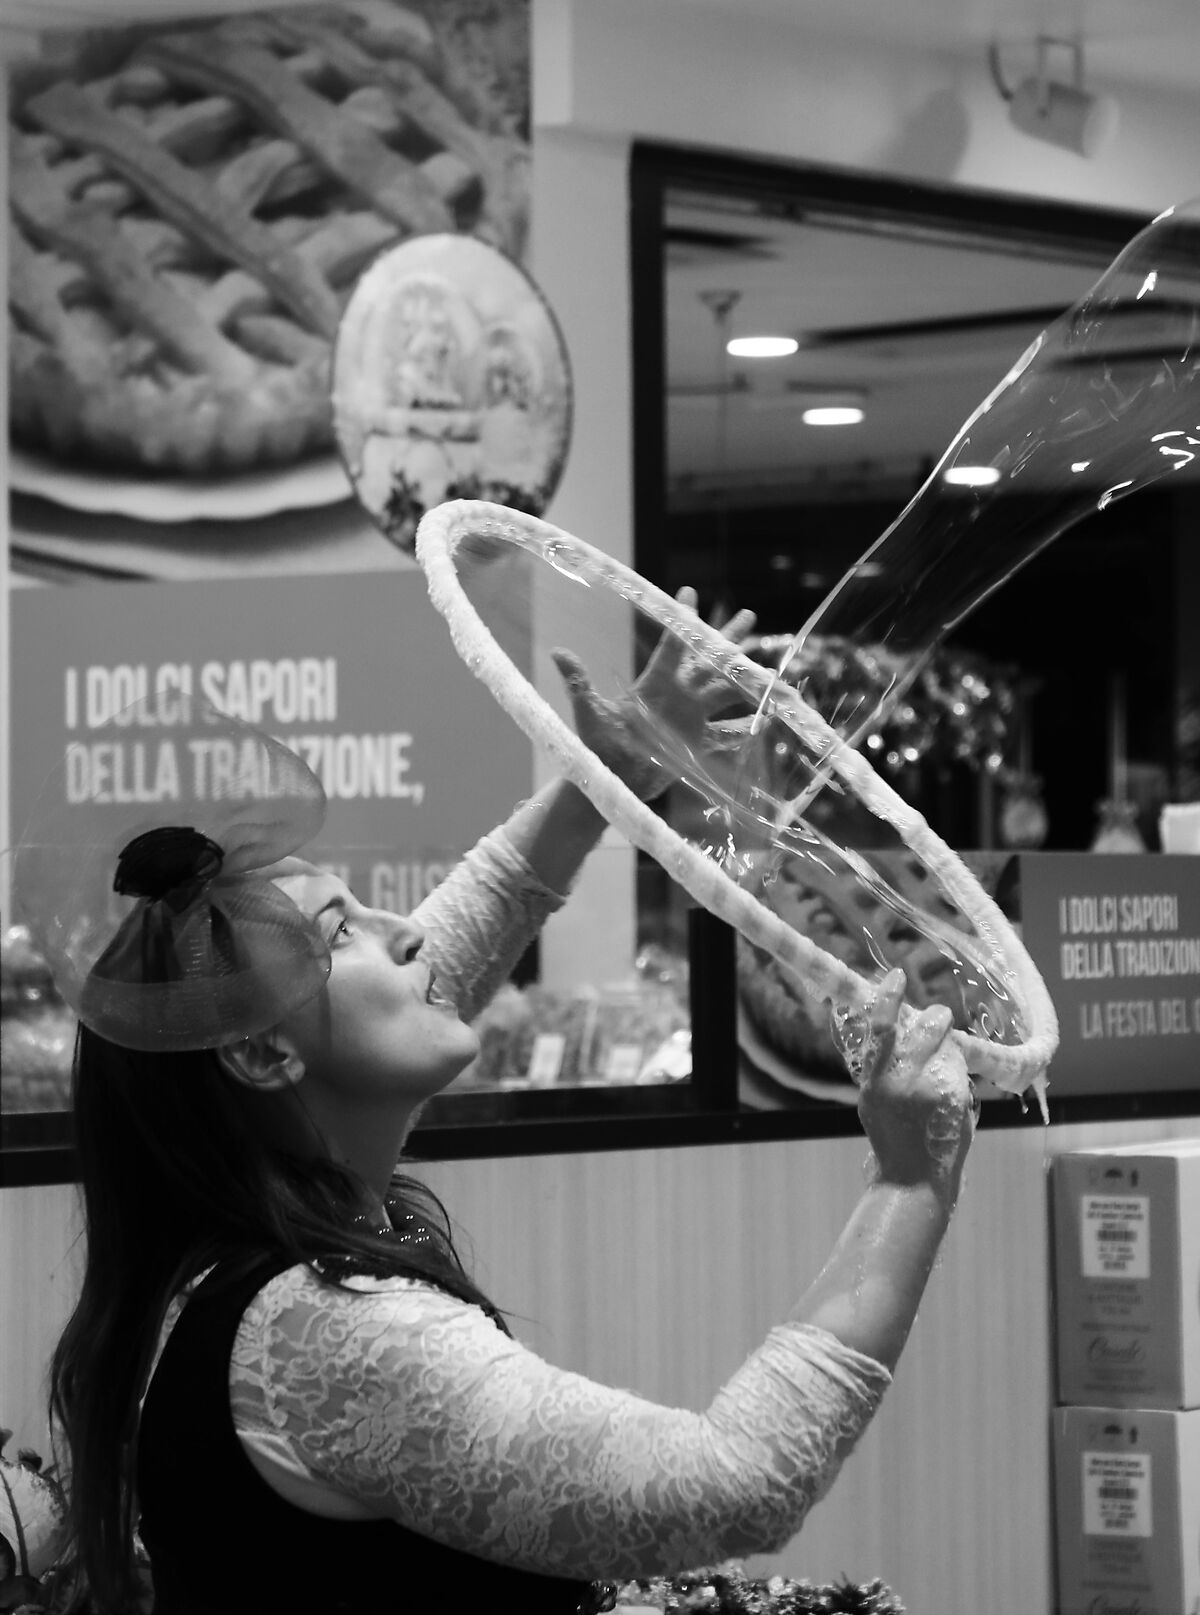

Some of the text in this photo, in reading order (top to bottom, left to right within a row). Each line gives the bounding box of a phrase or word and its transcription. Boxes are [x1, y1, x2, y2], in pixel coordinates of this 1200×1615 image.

[65, 656, 338, 730] I DOLCI SAPORI
[65, 738, 181, 805] DELLA
[1060, 895, 1178, 934] I DOLCI SAPORI
[1061, 942, 1114, 979] DELLA
[1081, 1002, 1103, 1039] LA
[1106, 1000, 1156, 1037] FESTA
[1159, 999, 1190, 1034] DEL
